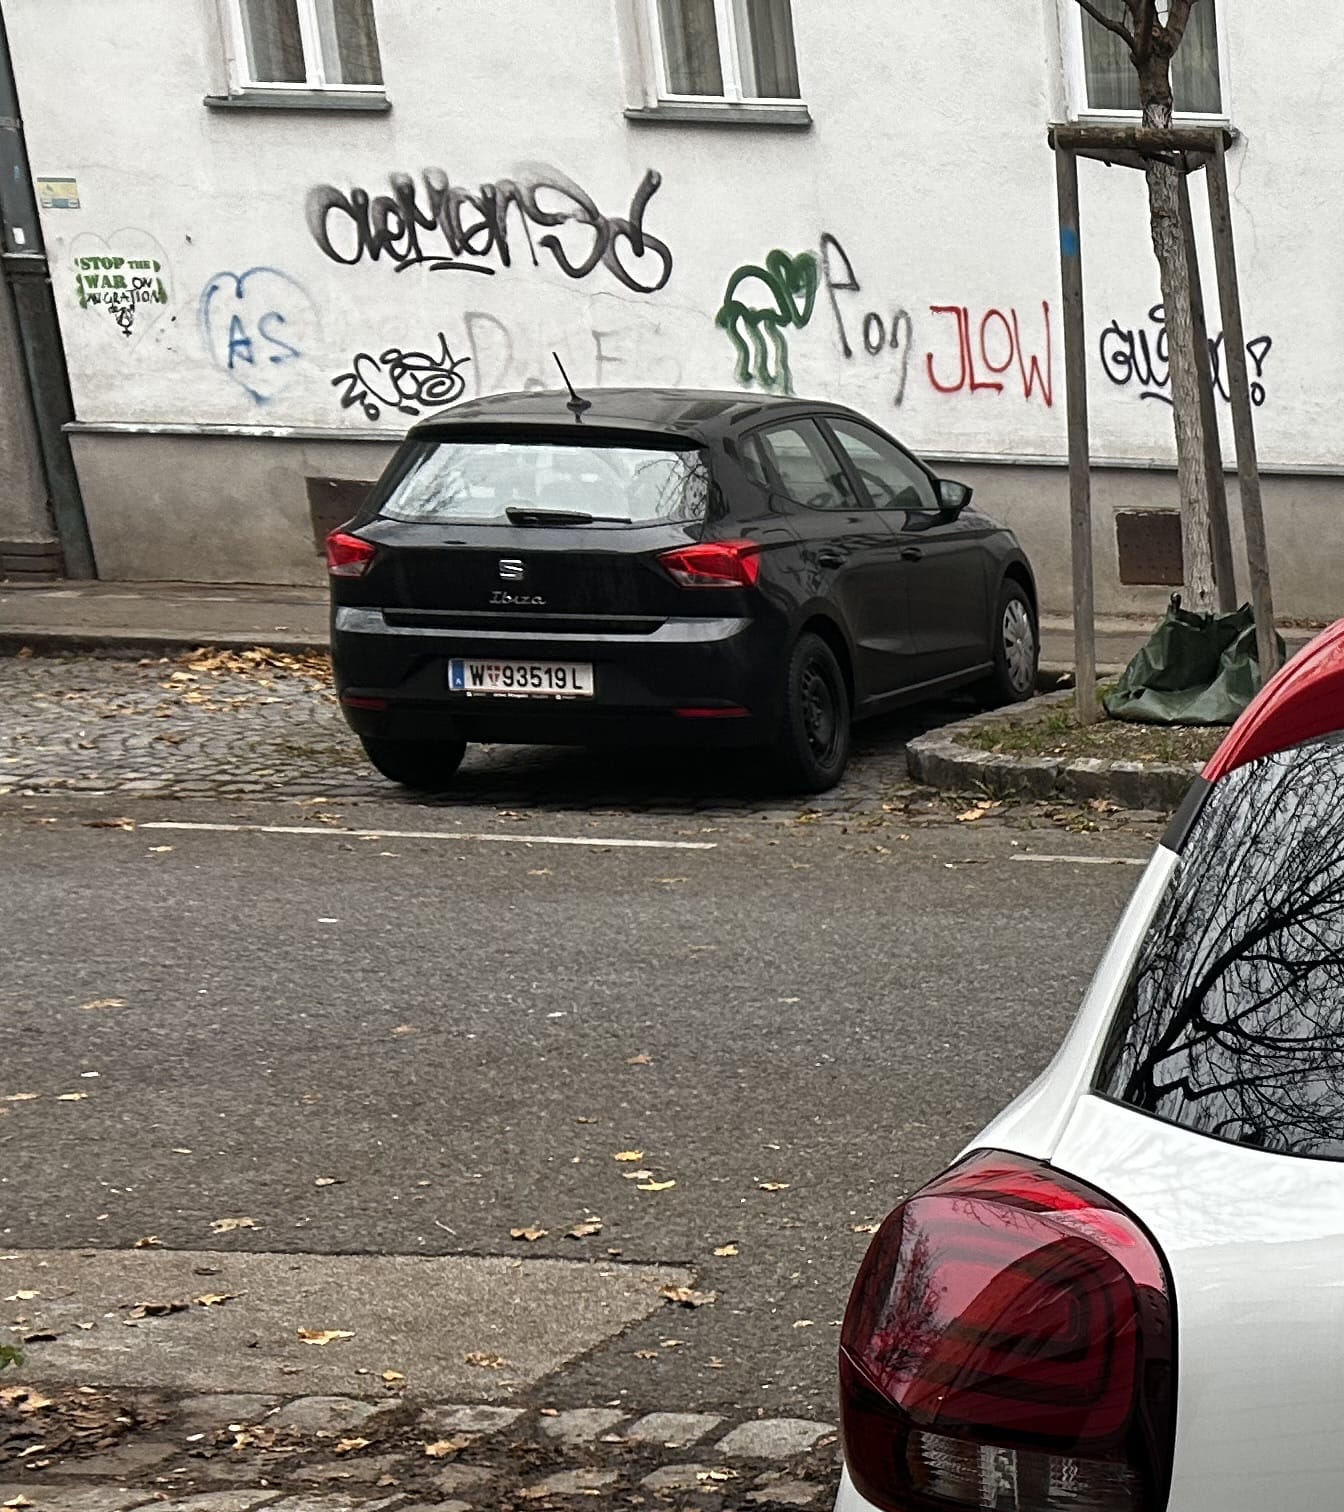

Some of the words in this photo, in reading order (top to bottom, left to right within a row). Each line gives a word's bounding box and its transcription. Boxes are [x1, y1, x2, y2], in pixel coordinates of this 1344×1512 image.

[80, 256, 125, 270] STOP
[127, 260, 151, 270] THE
[84, 274, 128, 290] WAR
[132, 276, 153, 290] ON
[227, 310, 303, 369] AS
[490, 591, 547, 605] Ibiza
[469, 664, 485, 686] W
[502, 665, 566, 689] 93519
